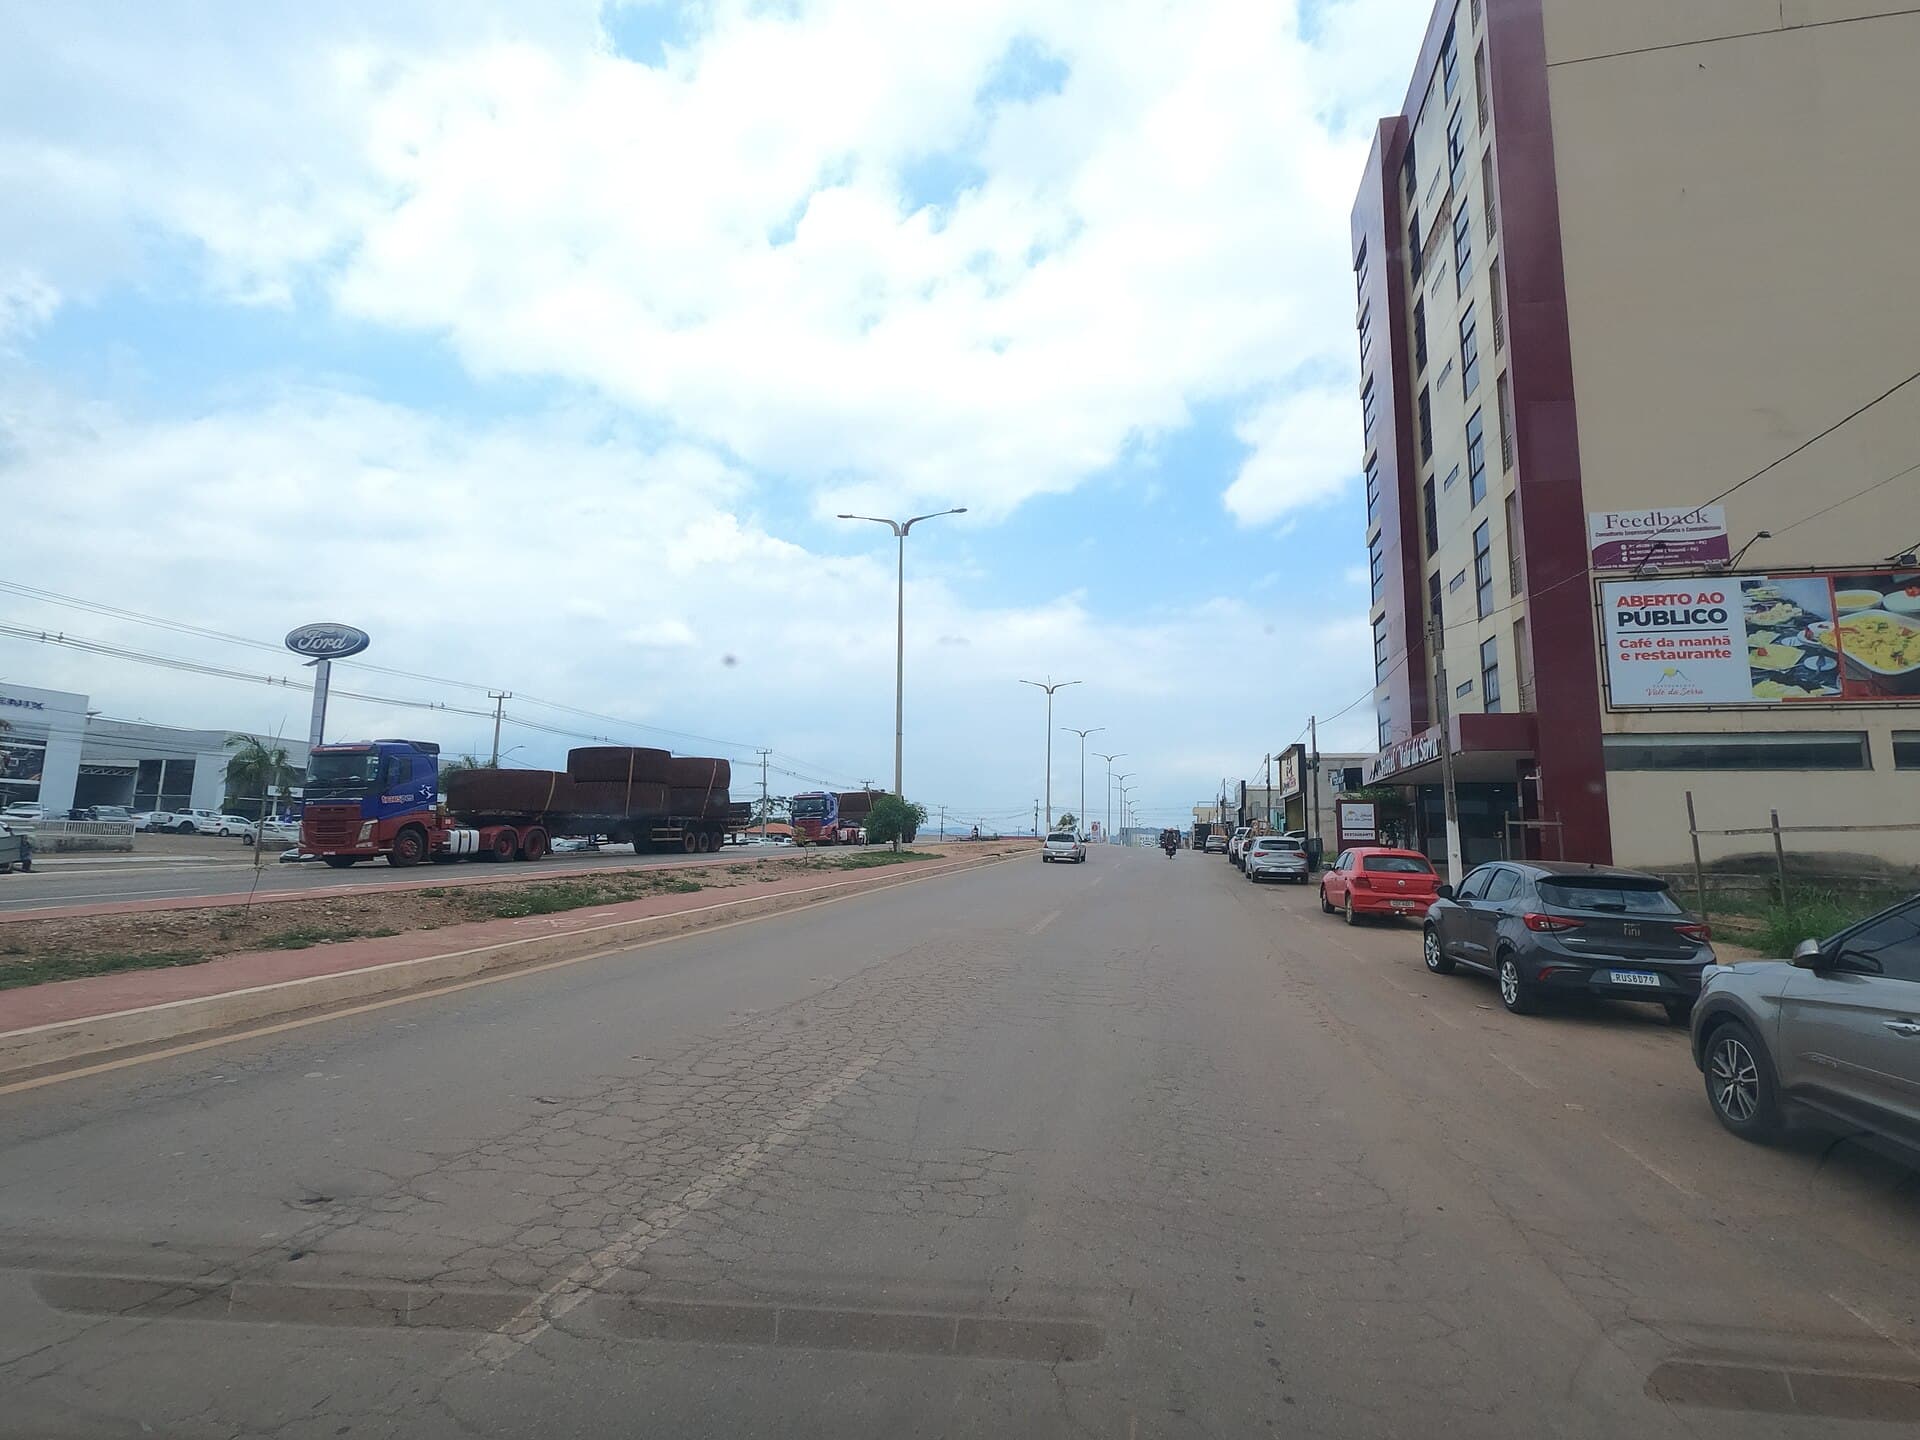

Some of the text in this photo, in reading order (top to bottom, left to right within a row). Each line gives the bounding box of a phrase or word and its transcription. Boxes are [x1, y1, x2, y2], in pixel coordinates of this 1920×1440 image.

[1605, 510, 1708, 529] Feedback
[1617, 592, 1725, 608] ABERTO AO
[1617, 607, 1728, 627] PÚBLICO
[297, 629, 347, 650] Ford
[1619, 635, 1731, 649] Café da manhã
[1620, 649, 1732, 661] e restaurante
